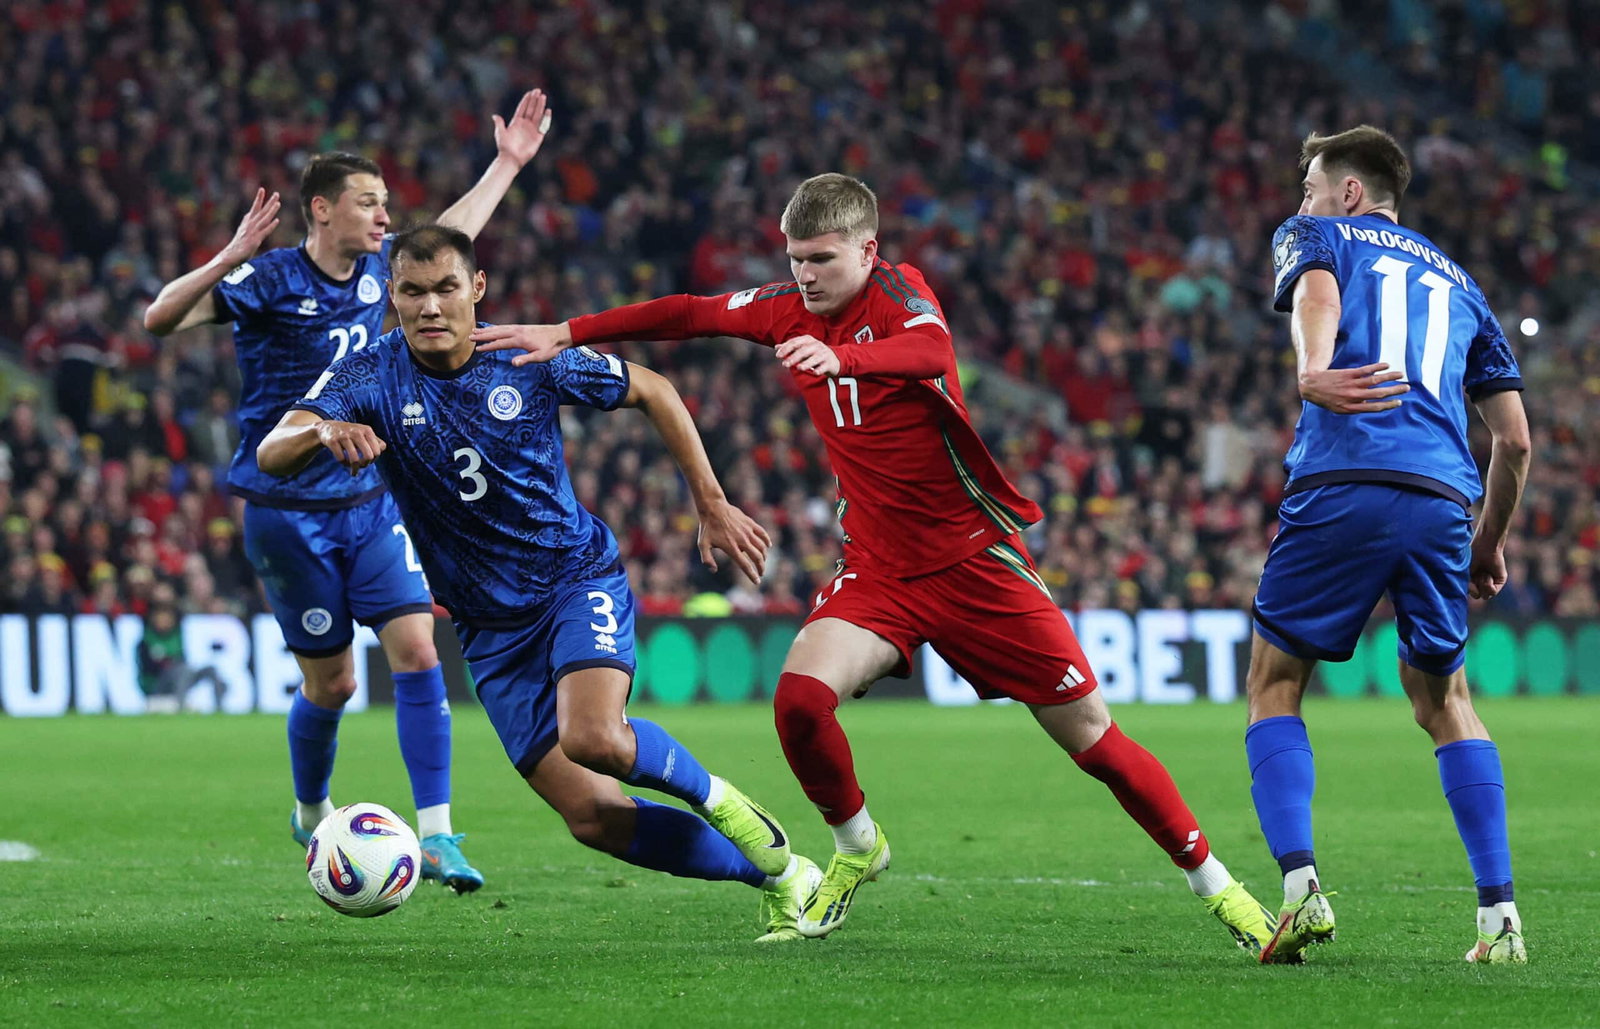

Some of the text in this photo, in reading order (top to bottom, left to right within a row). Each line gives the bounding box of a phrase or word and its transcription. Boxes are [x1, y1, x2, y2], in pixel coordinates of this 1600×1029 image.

[1371, 254, 1457, 401] 11
[827, 376, 862, 428] 17
[453, 447, 489, 502] 3
[587, 590, 619, 635] 3
